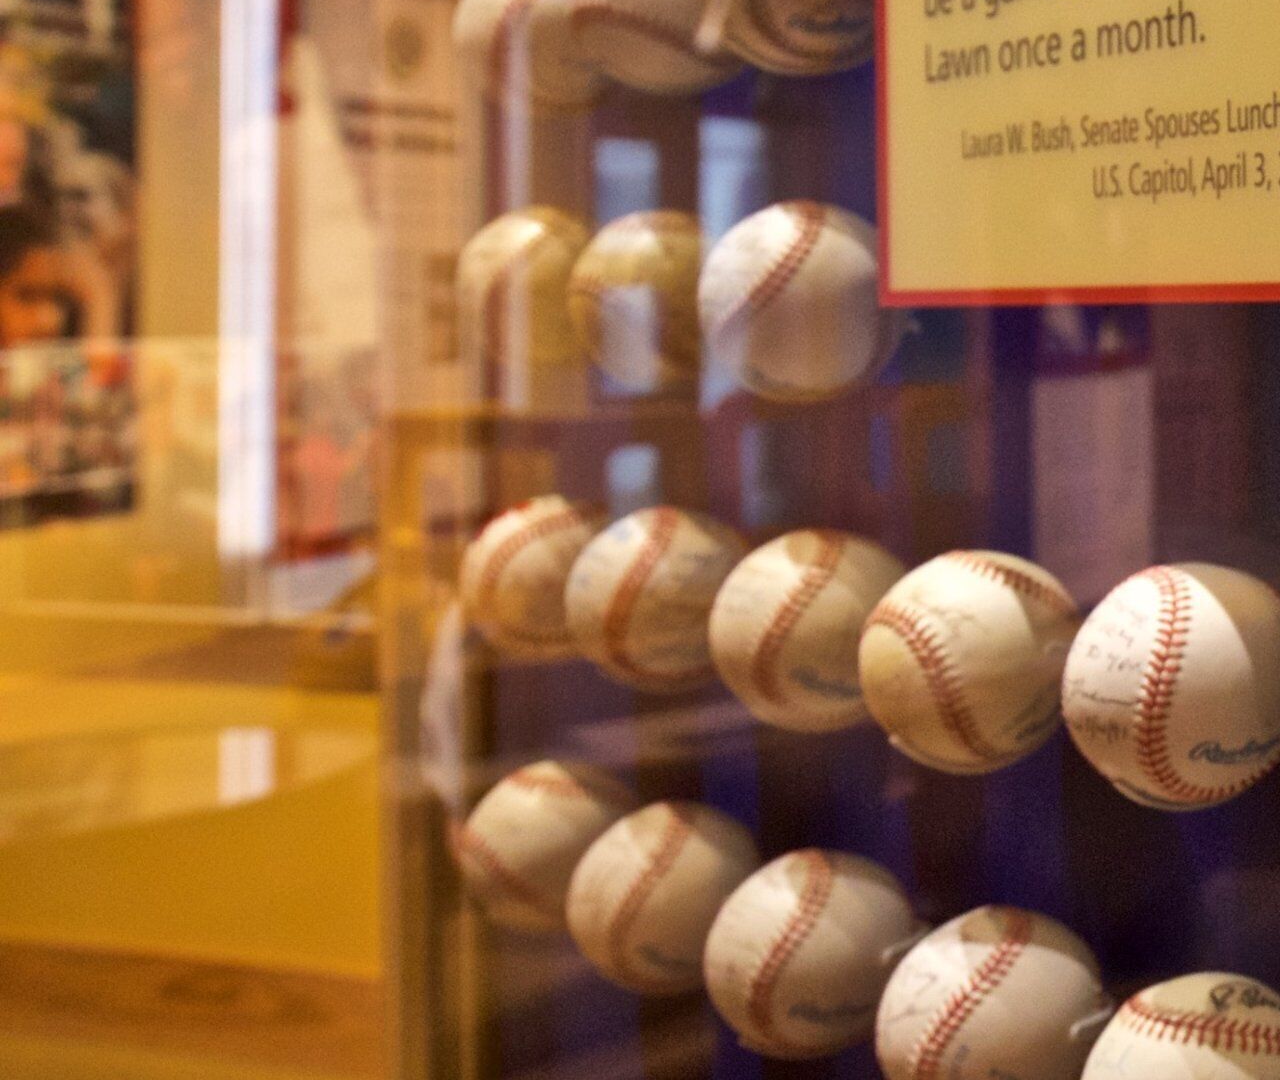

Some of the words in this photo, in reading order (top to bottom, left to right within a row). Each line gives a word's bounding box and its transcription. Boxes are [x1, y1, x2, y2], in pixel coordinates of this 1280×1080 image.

[924, 41, 991, 84] Lawn
[999, 30, 1063, 73] once
[1070, 27, 1087, 62] a
[961, 127, 1004, 160] Laura
[1005, 124, 1028, 154] W.
[1031, 115, 1075, 154] Bush,
[1081, 114, 1140, 149] Senate
[1144, 106, 1221, 148] Spouses
[1092, 162, 1124, 200] U.S.
[1128, 155, 1197, 204] Capitol,
[1201, 151, 1248, 200] April
[1253, 151, 1272, 191] 3,
